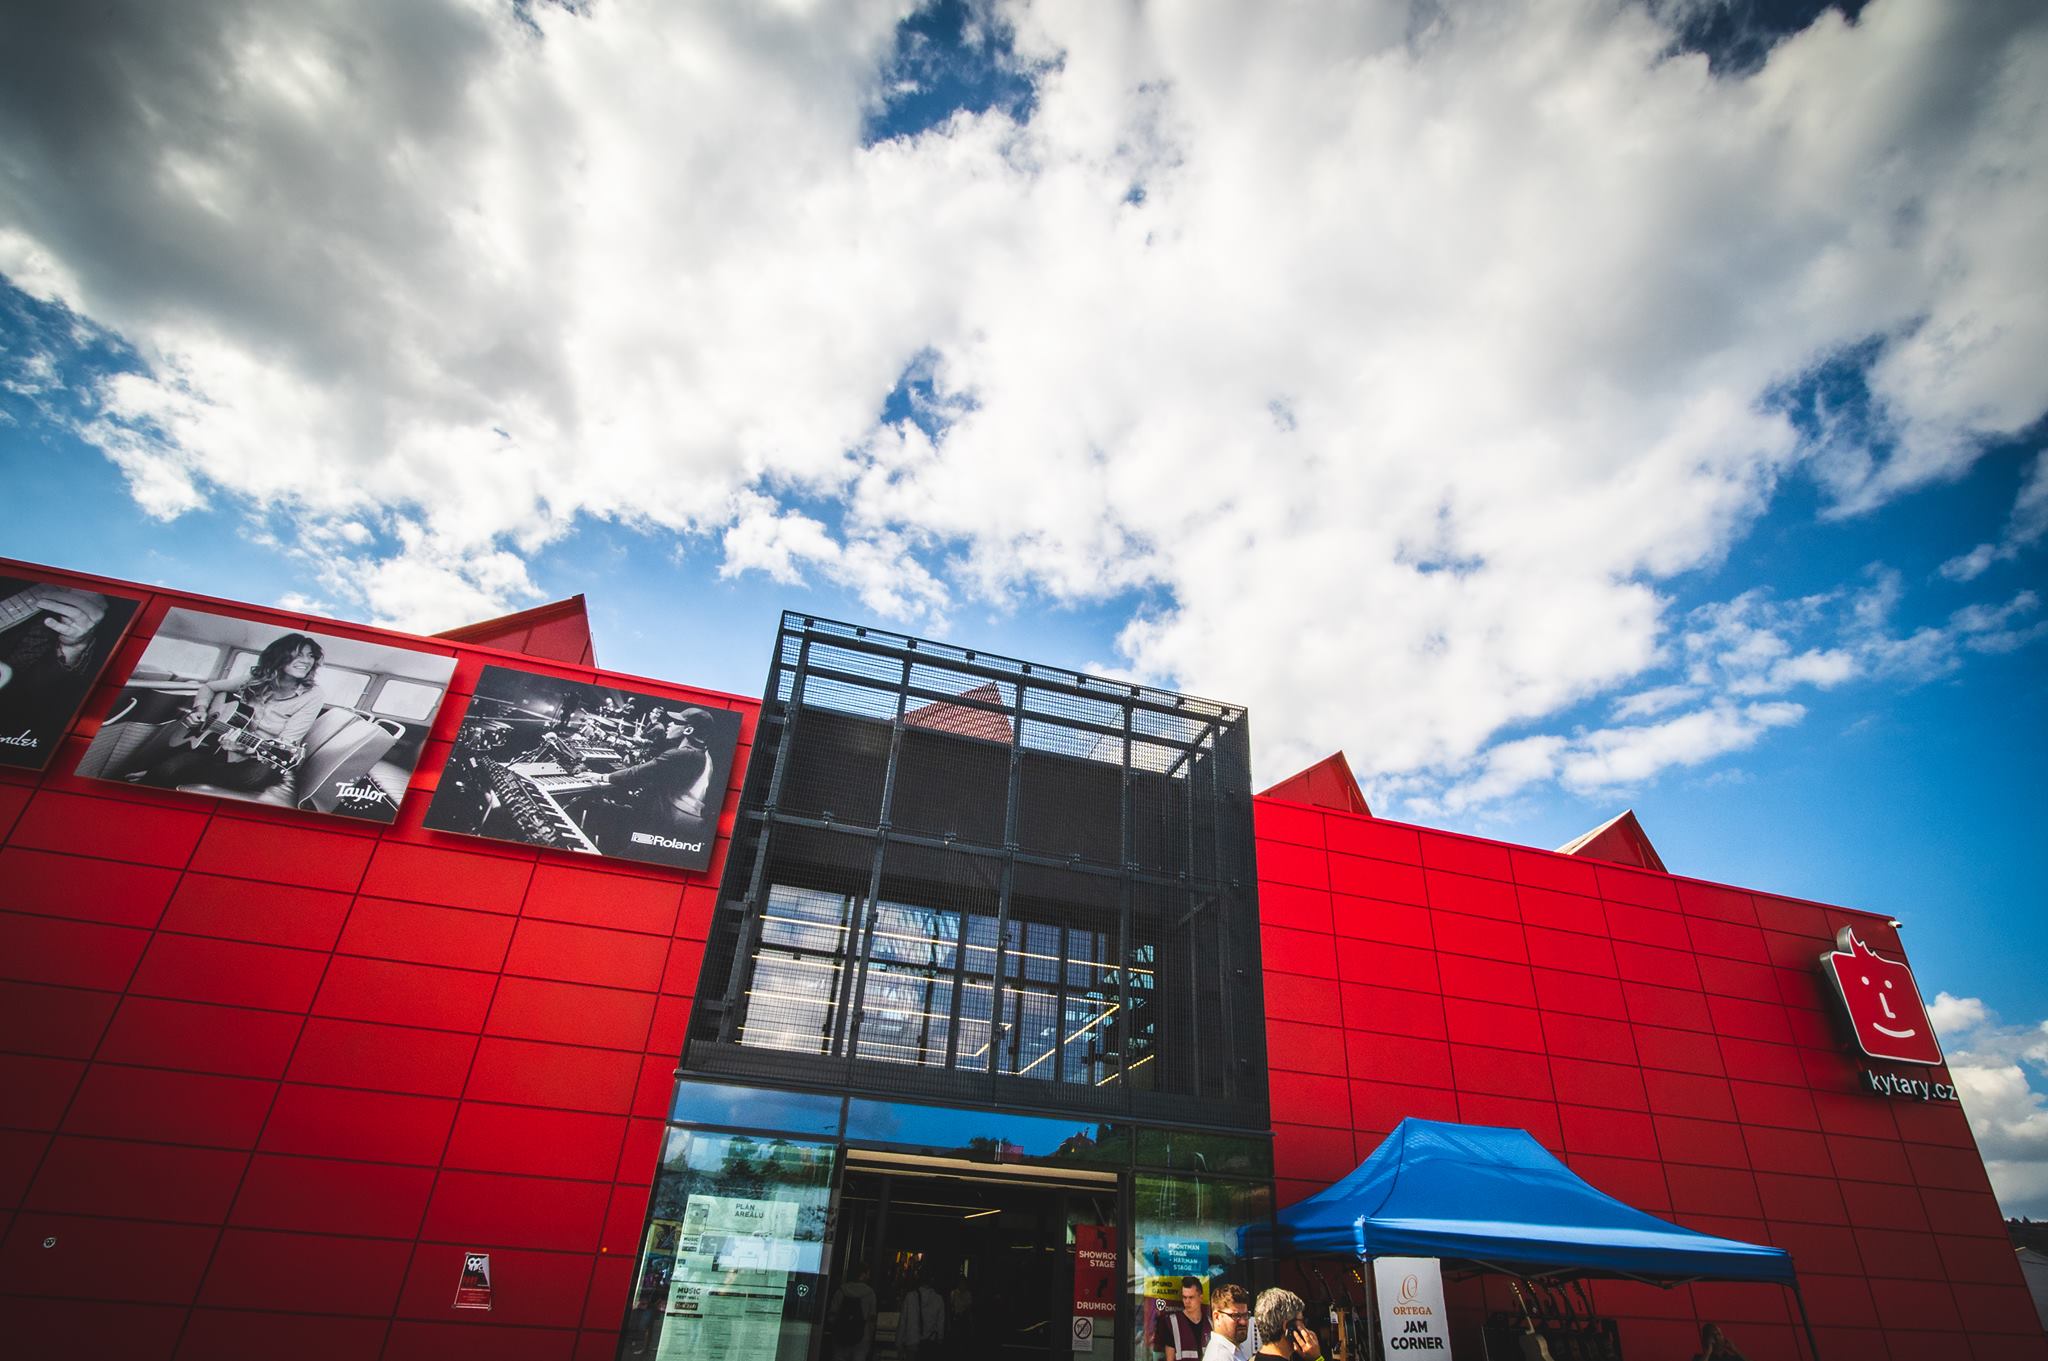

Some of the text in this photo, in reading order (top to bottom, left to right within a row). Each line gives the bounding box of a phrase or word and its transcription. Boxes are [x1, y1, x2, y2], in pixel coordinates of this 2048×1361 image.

[336, 782, 387, 803] Taylor
[653, 835, 702, 852] Roland
[1868, 1069, 1959, 1101] kytary.cz
[735, 1203, 756, 1211] PLAN
[1090, 1259, 1115, 1268] STAGE
[677, 1287, 701, 1295] MUSIC
[1393, 1306, 1432, 1315] ORTEGA
[1403, 1320, 1428, 1333] JAM
[1391, 1336, 1444, 1350] CORNER
